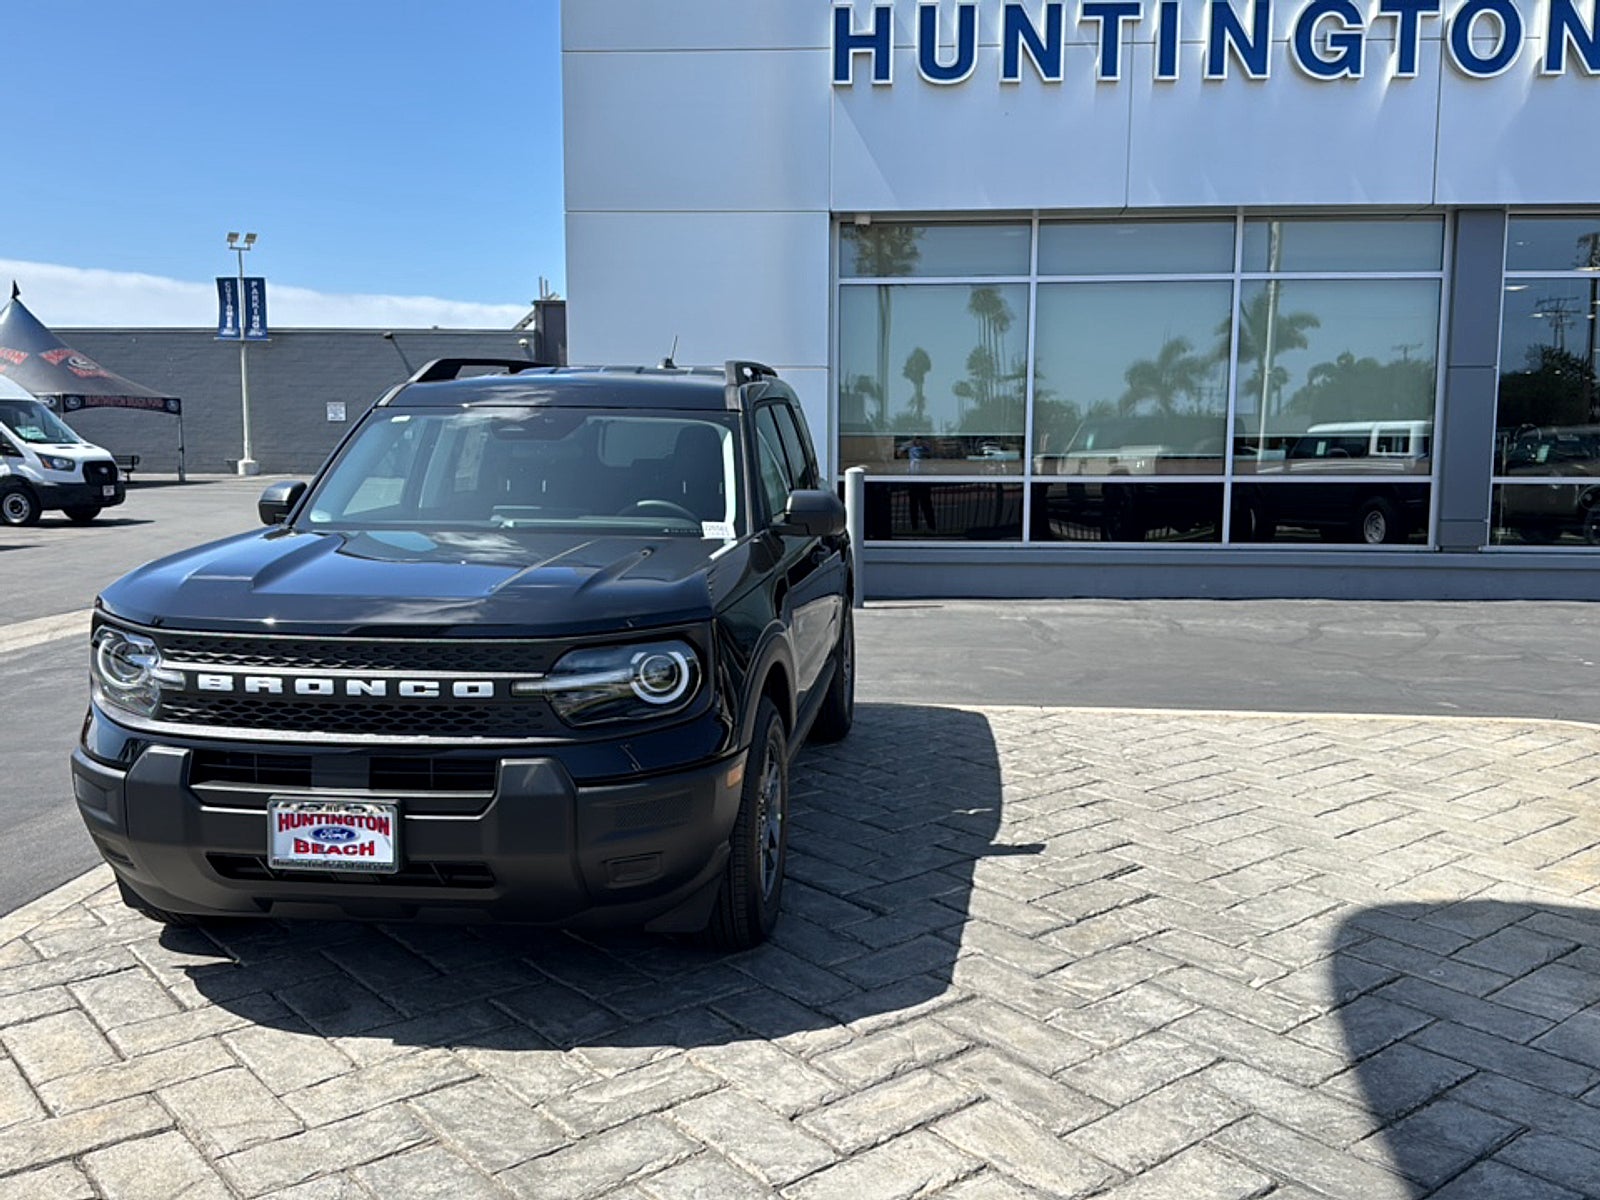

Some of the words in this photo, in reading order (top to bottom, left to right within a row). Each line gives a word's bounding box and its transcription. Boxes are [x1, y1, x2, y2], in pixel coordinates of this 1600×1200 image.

[831, 0, 1600, 85] HUNTINGTON
[251, 281, 260, 329] PARKING
[198, 674, 494, 697] BRONCO
[278, 813, 390, 836] HUNTINGTON
[293, 838, 375, 856] BEACH
